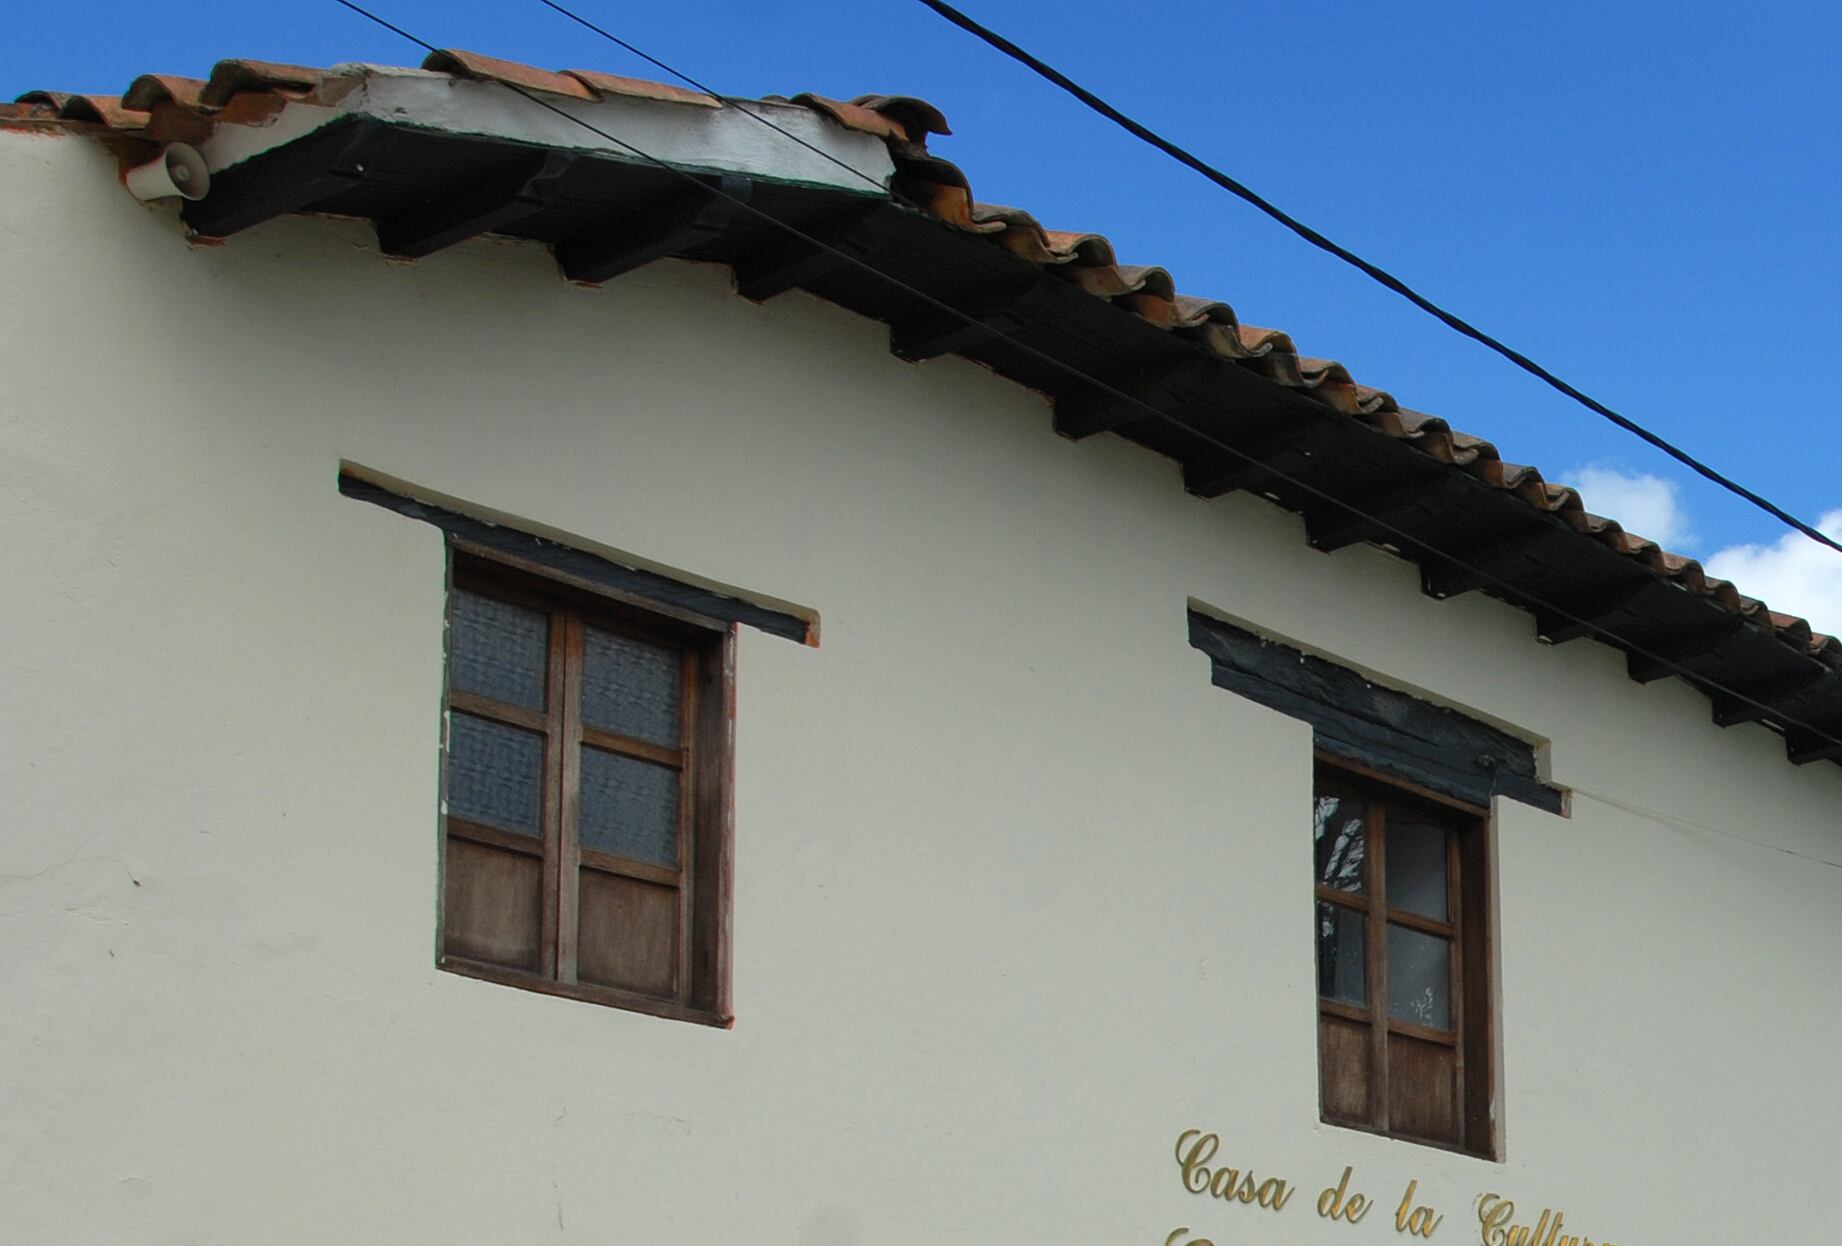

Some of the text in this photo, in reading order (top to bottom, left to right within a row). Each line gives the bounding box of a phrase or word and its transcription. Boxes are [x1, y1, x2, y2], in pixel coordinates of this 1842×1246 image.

[1175, 1128, 1295, 1211] Casa
[1316, 1166, 1373, 1224] de
[1395, 1179, 1443, 1238] la
